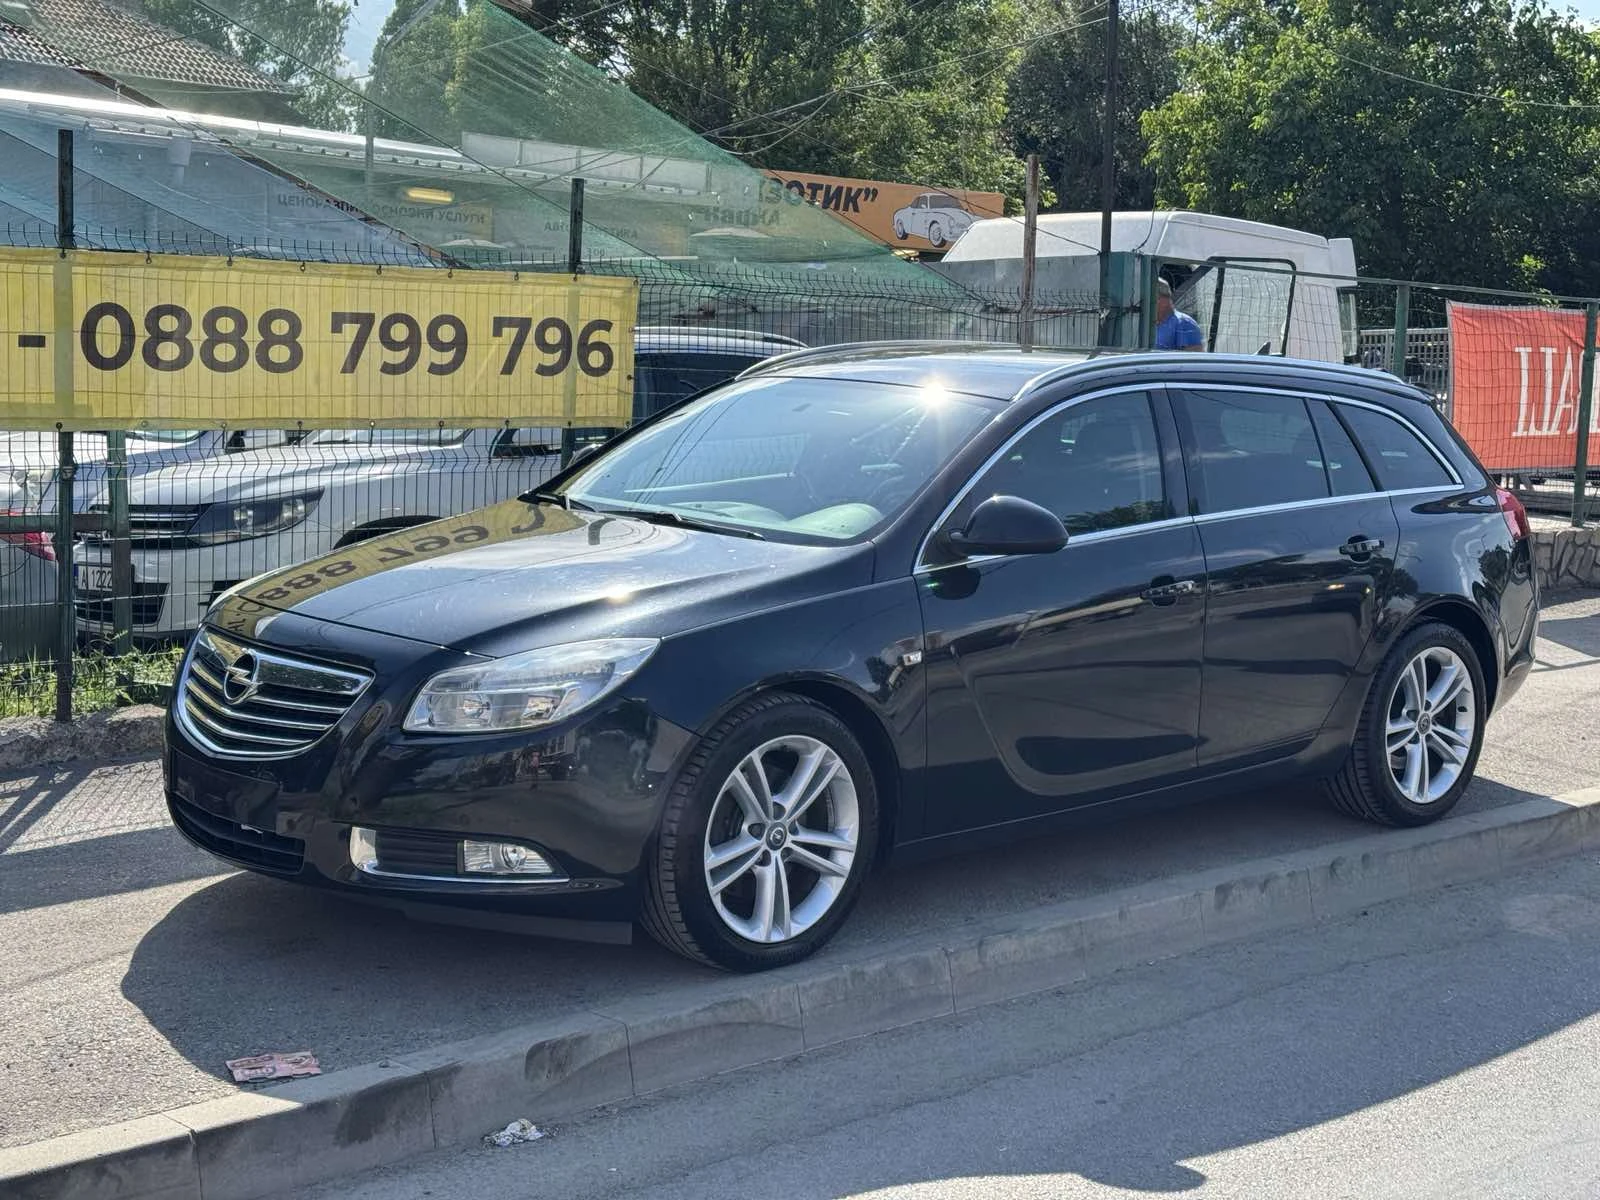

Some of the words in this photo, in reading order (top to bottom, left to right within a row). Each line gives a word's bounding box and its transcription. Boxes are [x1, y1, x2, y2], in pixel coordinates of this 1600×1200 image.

[80, 302, 304, 374] 0888
[331, 311, 468, 376] 799
[492, 316, 615, 377] 796
